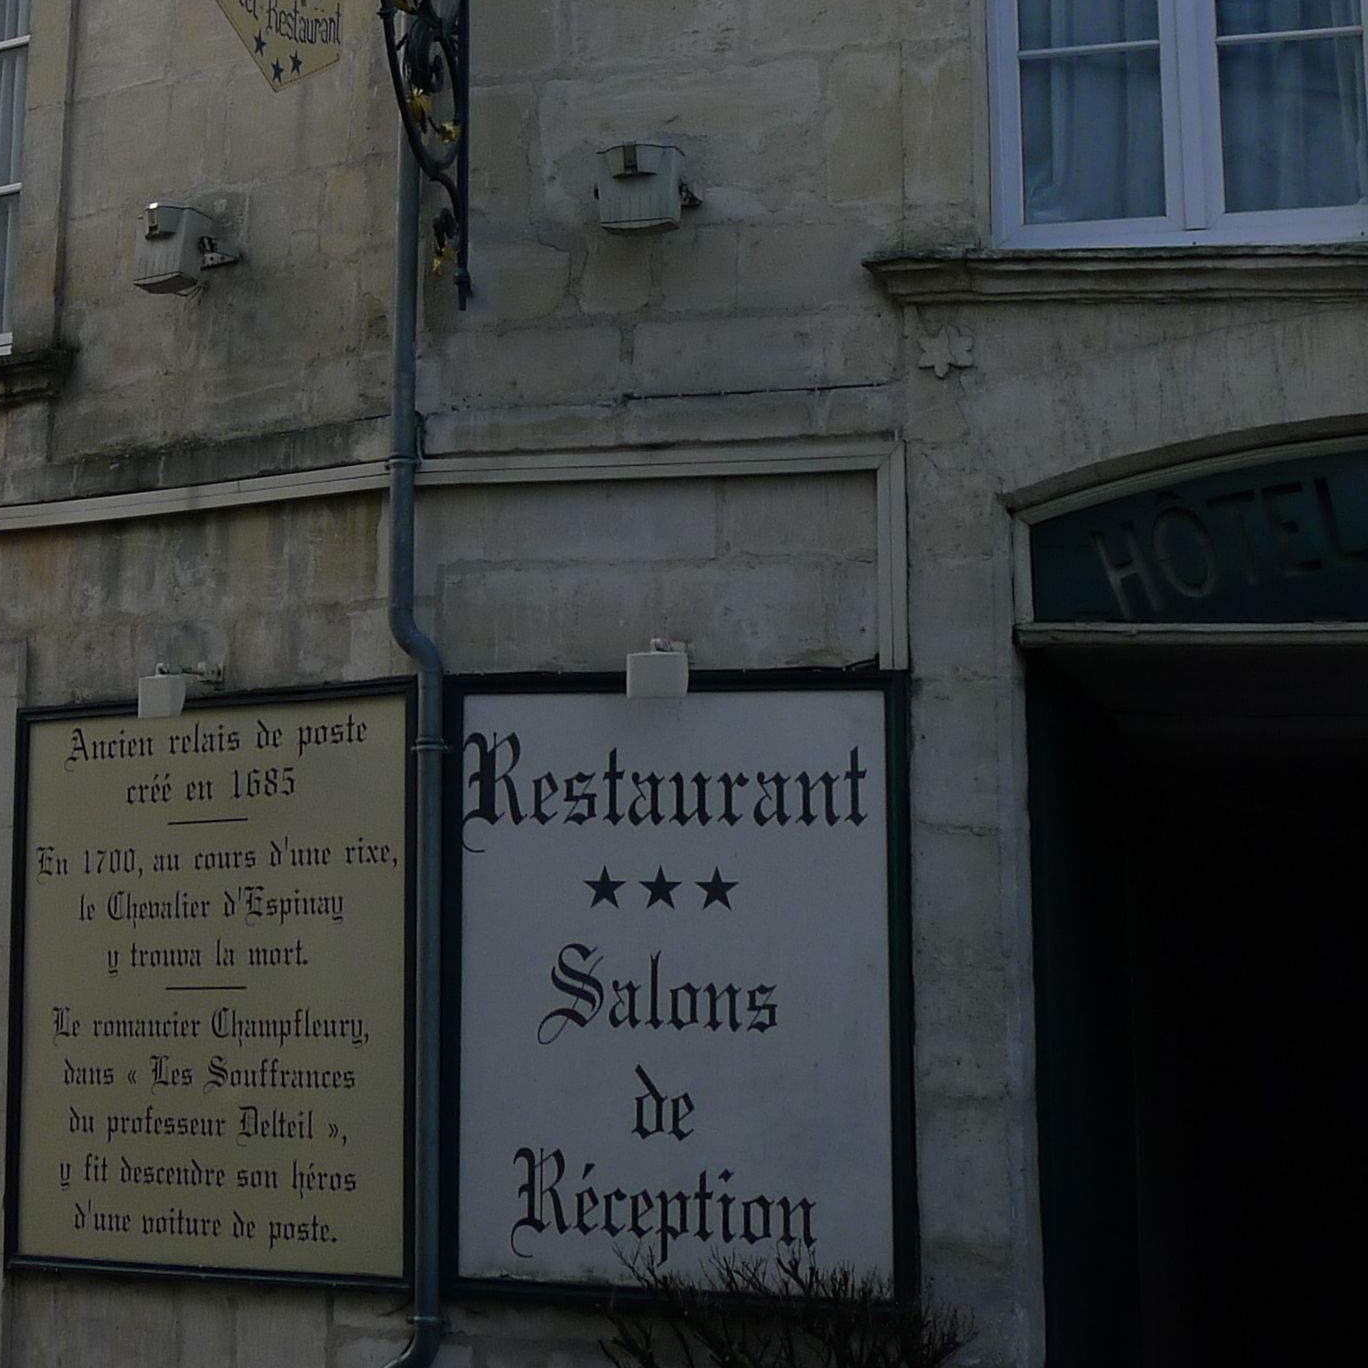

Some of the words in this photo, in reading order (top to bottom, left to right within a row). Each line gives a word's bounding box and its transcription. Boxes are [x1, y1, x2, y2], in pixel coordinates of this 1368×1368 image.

[64, 728, 153, 772] Ancien
[168, 722, 240, 755] relais
[256, 720, 282, 749] de
[297, 714, 367, 757] poste
[126, 774, 171, 805] créé
[186, 778, 213, 801] en
[231, 767, 296, 800] 1685
[462, 731, 868, 853] Restaurant
[36, 846, 68, 884] En
[83, 848, 143, 877] 1700,
[152, 853, 179, 872] au
[194, 849, 256, 870] cours
[269, 836, 331, 868] d'une
[345, 837, 398, 869] rixe,
[79, 893, 95, 921] le
[107, 889, 211, 928] Chevalier
[223, 886, 344, 927] d'Espinay
[107, 950, 119, 977] y
[131, 944, 201, 968] trouva
[216, 939, 234, 967] la
[248, 939, 308, 966] mort.
[537, 942, 779, 1046] Salons
[51, 1007, 80, 1047] Le
[93, 1012, 200, 1038] romancier
[211, 1007, 369, 1049] Champfleury,
[63, 1059, 114, 1085] dans
[150, 1055, 193, 1095] Les
[203, 1056, 356, 1094] Souffrances
[633, 1064, 695, 1140] de
[69, 1107, 94, 1133] du
[107, 1106, 226, 1143] professeur
[235, 1106, 314, 1147] Delteil
[60, 1162, 71, 1191] y
[85, 1153, 108, 1183] fit
[121, 1156, 225, 1188] descendre
[237, 1166, 278, 1188] son
[292, 1160, 356, 1199] héros
[74, 1200, 131, 1232] d'une
[142, 1208, 221, 1237] voiture
[232, 1211, 255, 1239] de
[269, 1215, 338, 1249] poste.
[510, 1147, 818, 1267] Réception
